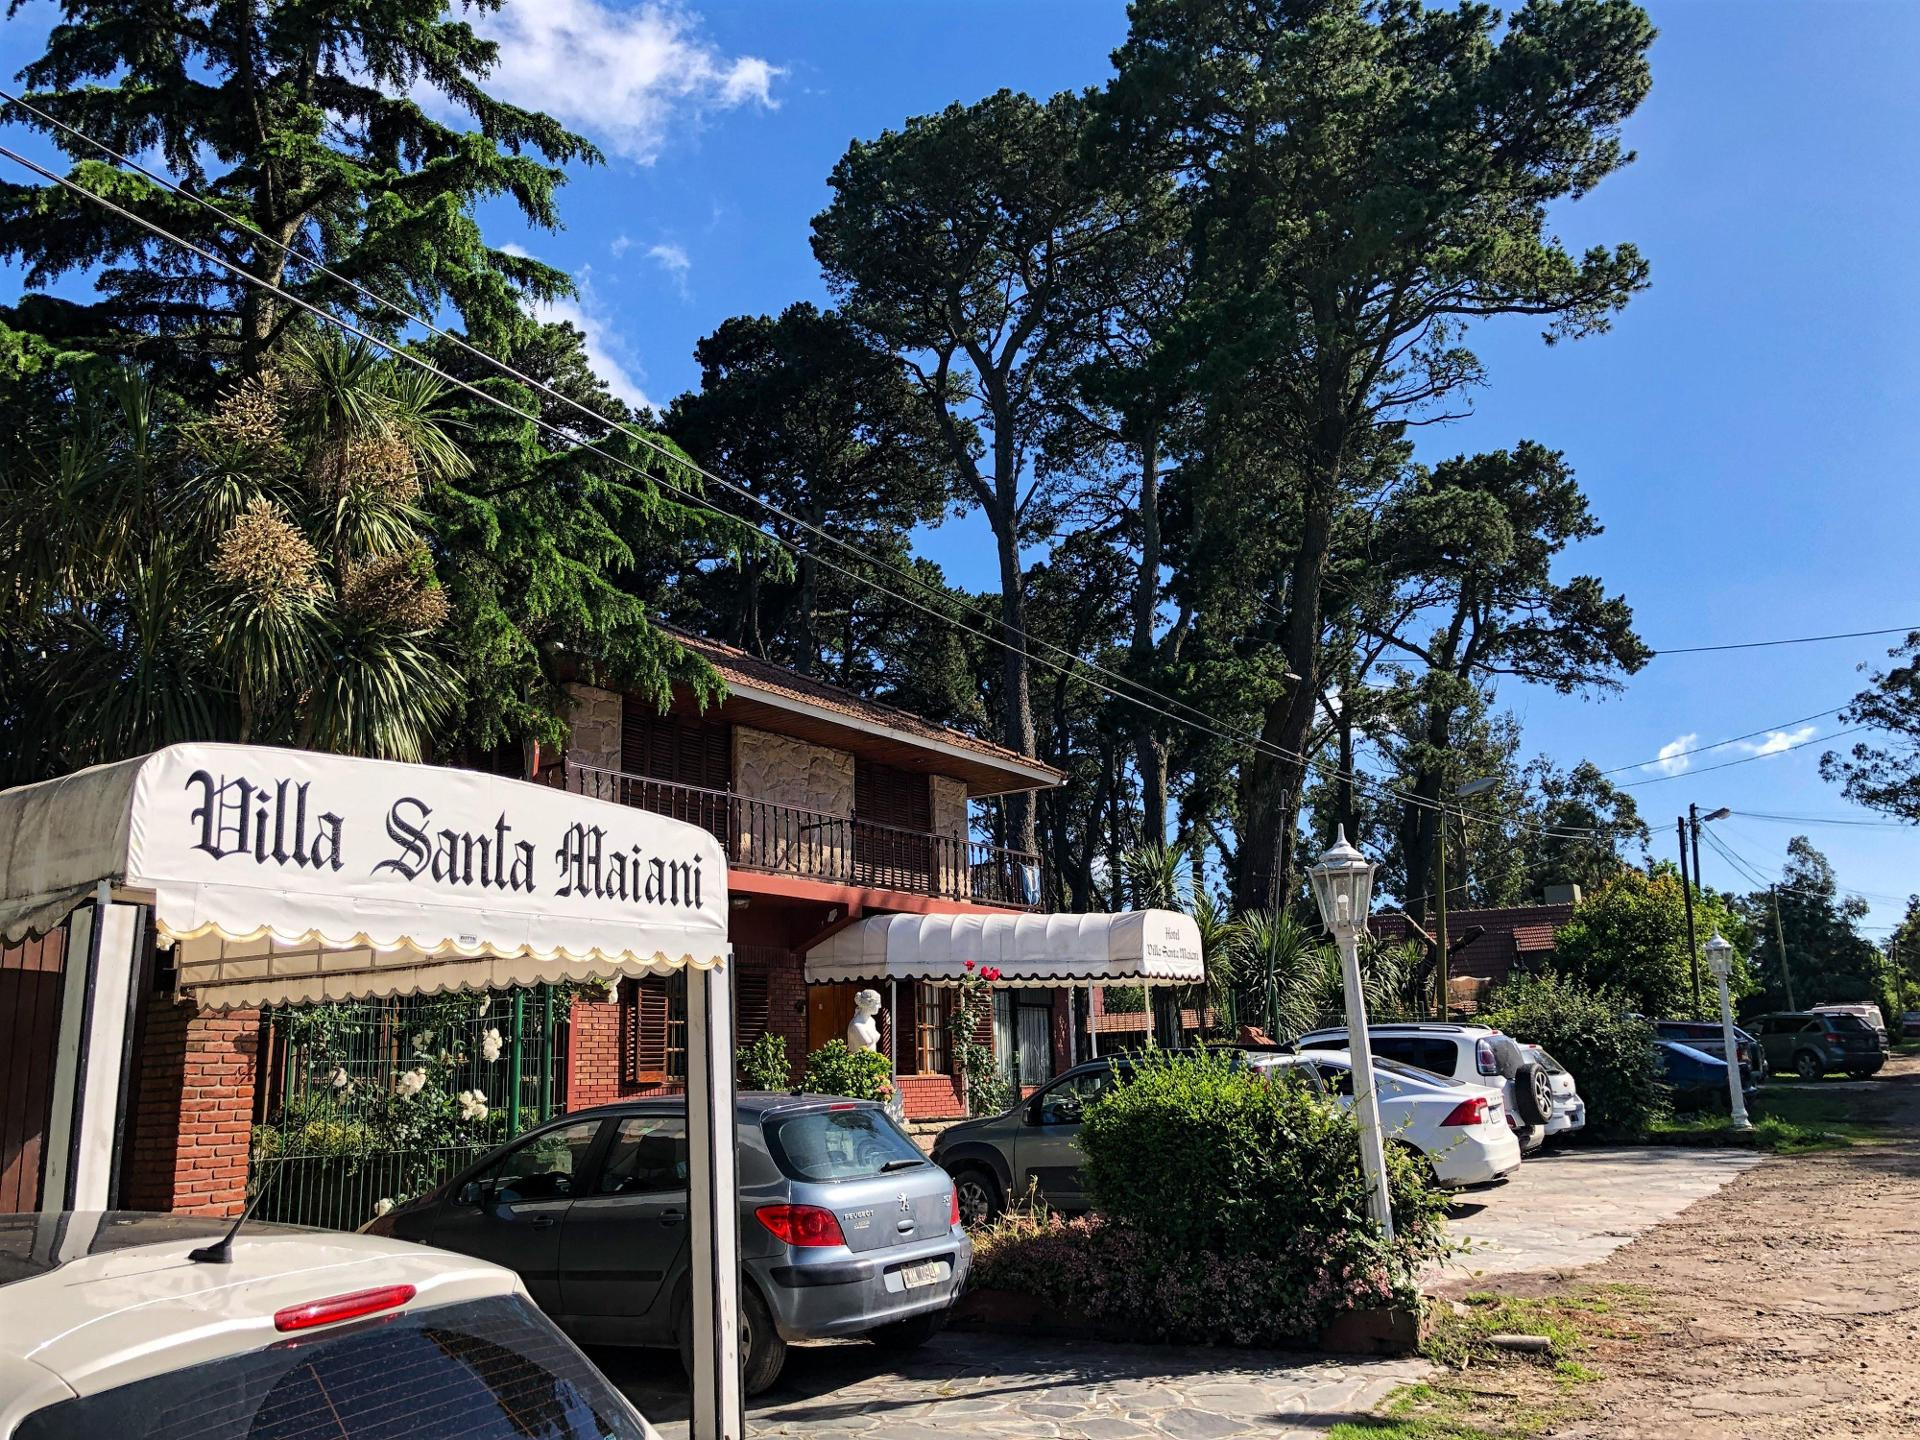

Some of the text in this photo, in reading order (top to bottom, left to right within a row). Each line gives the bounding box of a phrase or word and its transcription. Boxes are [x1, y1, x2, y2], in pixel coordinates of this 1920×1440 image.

[184, 769, 704, 910] Villa Santa Maiani
[1165, 927, 1180, 941] Hotel
[1146, 943, 1161, 957] Villa
[1162, 945, 1179, 959] Santa
